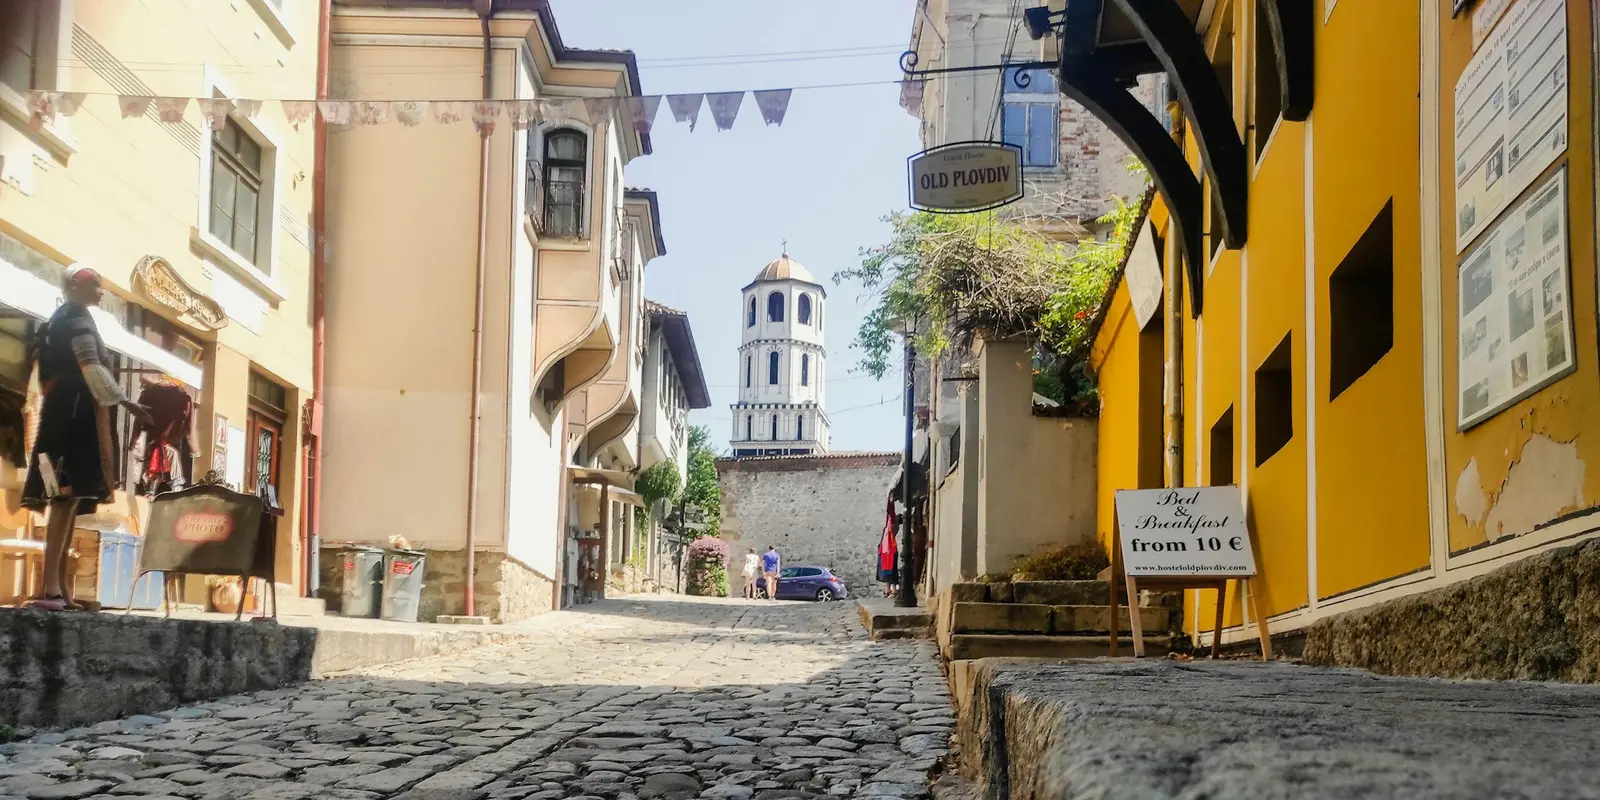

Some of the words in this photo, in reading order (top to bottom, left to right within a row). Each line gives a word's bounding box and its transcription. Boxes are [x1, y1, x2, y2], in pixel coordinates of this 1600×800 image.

[1493, 38, 1500, 49] 10
[964, 152, 985, 161] House
[920, 172, 949, 190] OLD
[953, 166, 1010, 187] PLOVDIV
[1157, 491, 1200, 505] Bed
[1174, 506, 1190, 517] &
[184, 523, 224, 533] PHOTO
[1135, 515, 1229, 534] Breakfast
[1131, 538, 1187, 552] from
[1196, 537, 1221, 551] 10
[1229, 536, 1243, 551] €
[1134, 564, 1247, 573] www.hosteloldplovdiv.com
